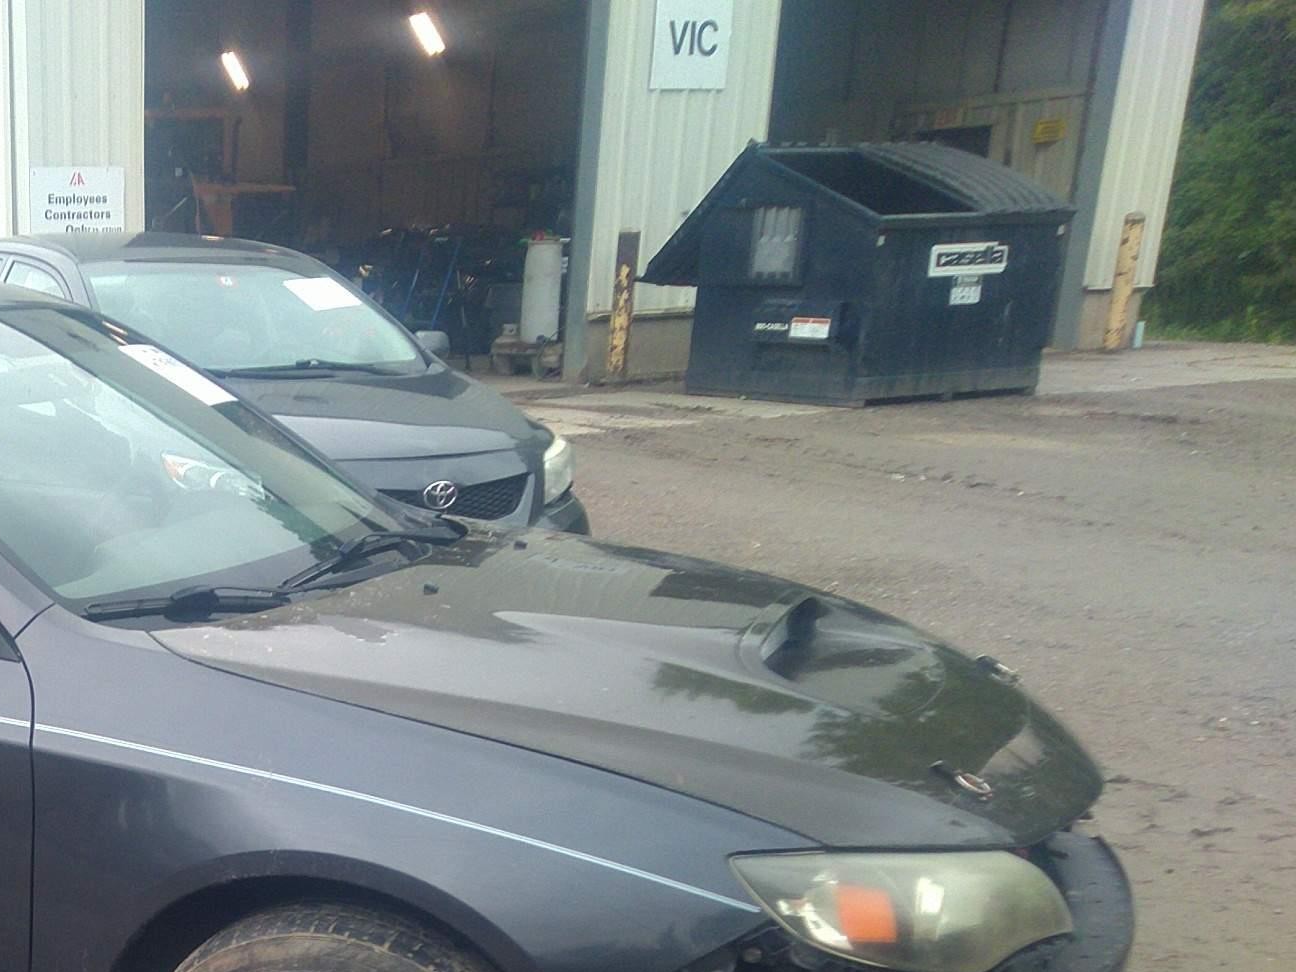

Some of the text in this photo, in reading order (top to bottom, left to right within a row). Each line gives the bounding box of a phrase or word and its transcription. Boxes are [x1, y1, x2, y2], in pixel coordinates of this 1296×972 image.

[669, 19, 719, 57] VIC
[47, 193, 107, 206] Employees
[44, 208, 111, 220] Contractors
